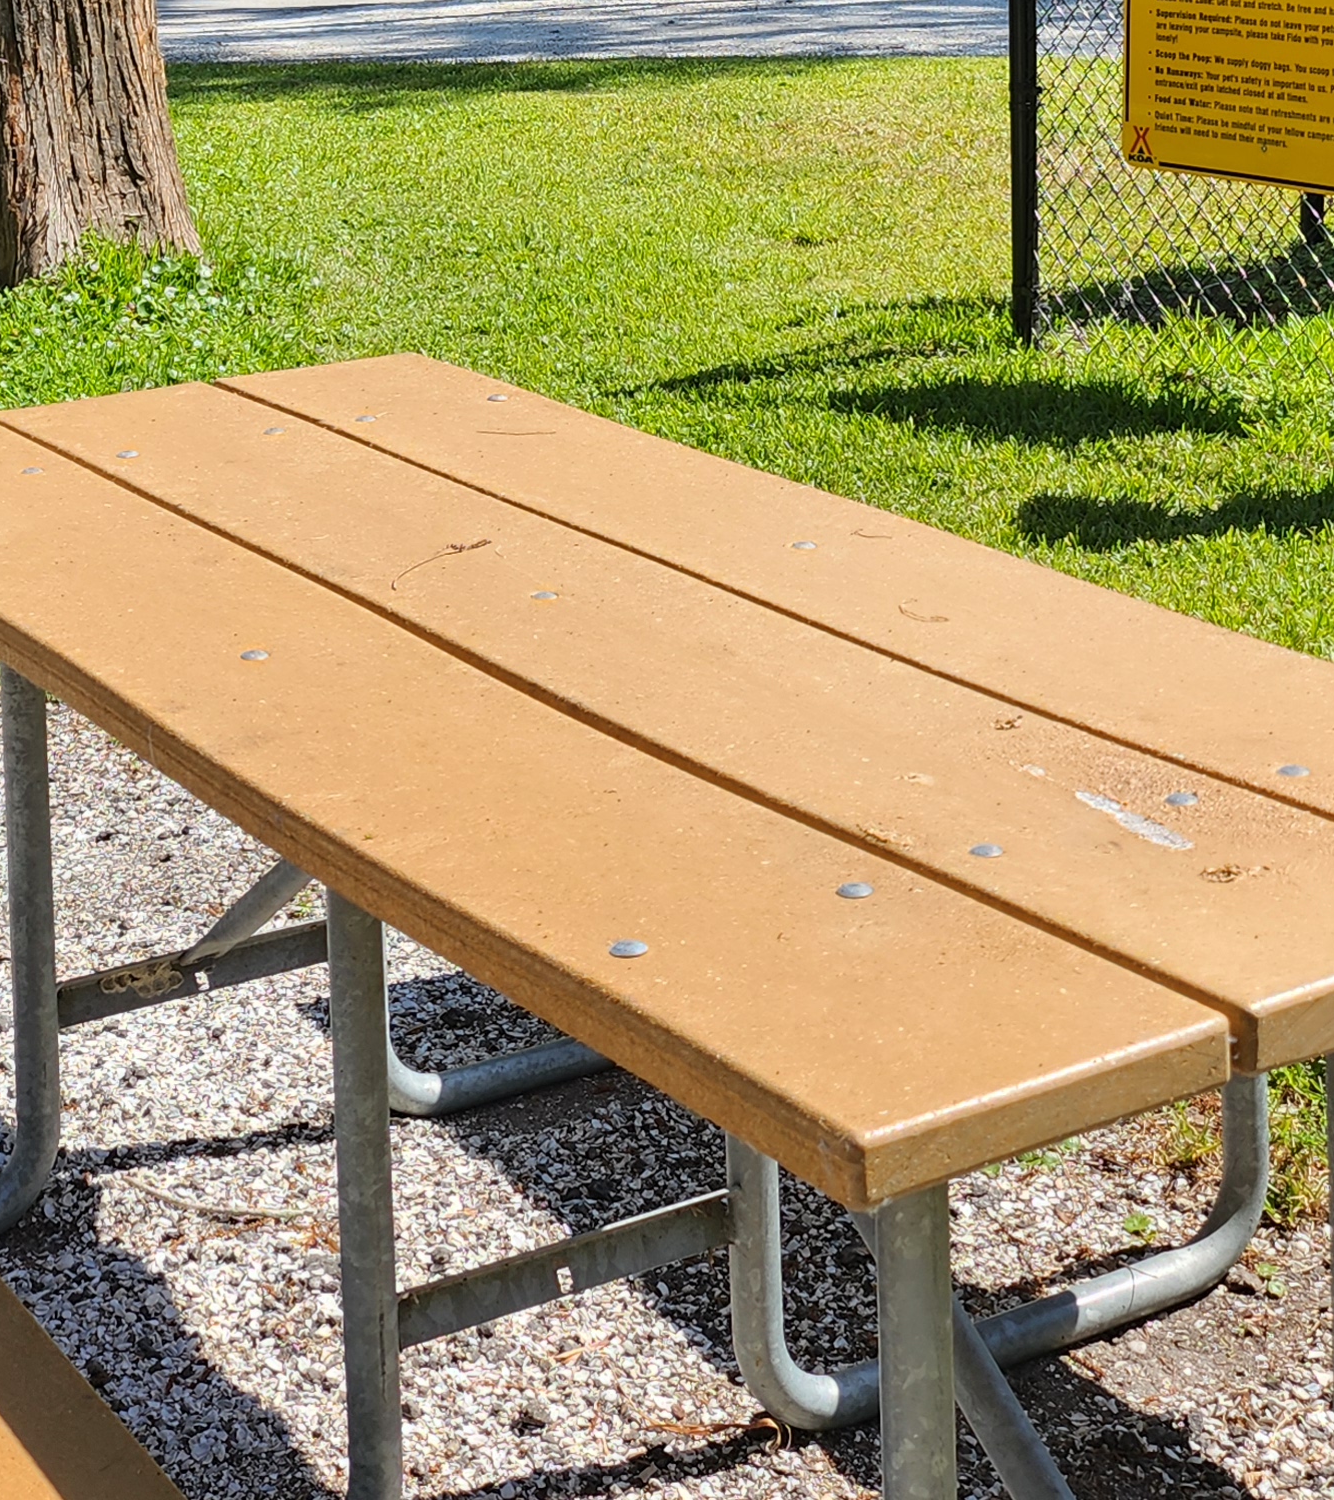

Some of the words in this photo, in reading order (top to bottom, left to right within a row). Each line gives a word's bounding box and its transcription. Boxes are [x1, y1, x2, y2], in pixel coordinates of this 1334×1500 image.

[1231, 0, 1241, 8] out
[1243, 0, 1256, 9] and
[1287, 3, 1295, 12] Be
[1297, 4, 1311, 14] free
[1314, 6, 1327, 15] and
[1156, 8, 1197, 20] Supervision
[1234, 15, 1257, 26] Please
[1259, 18, 1268, 27] do
[1270, 20, 1281, 28] not
[1283, 20, 1302, 30] leave
[1304, 24, 1320, 32] your
[1169, 22, 1193, 34] leaving
[1195, 26, 1209, 34] your
[1246, 30, 1268, 39] please
[1271, 32, 1285, 41] take
[1287, 33, 1301, 43] Fido
[1304, 35, 1319, 44] with
[1321, 38, 1333, 47] you
[1155, 49, 1176, 60] Scoop
[1179, 51, 1190, 60] the
[1214, 55, 1225, 64] We
[1227, 57, 1248, 68] supply
[1251, 59, 1271, 71] doggy
[1295, 63, 1307, 74] You
[1309, 66, 1329, 77] scoop
[1155, 66, 1164, 74] No
[1206, 71, 1220, 80] Your
[1241, 76, 1262, 87] safety
[1264, 77, 1270, 87] is
[1272, 78, 1306, 90] important
[1309, 82, 1315, 91] to
[1200, 83, 1214, 92] gate
[1216, 84, 1241, 96] latched
[1243, 87, 1265, 99] closed
[1268, 91, 1274, 99] at
[1277, 92, 1285, 100] all
[1155, 94, 1171, 104] Food
[1174, 96, 1186, 106] and
[1214, 101, 1236, 112] Please
[1239, 104, 1253, 114] note
[1256, 106, 1269, 116] that
[1319, 115, 1330, 124] are
[1155, 110, 1173, 121] Quiet
[1196, 115, 1218, 127] Please
[1221, 118, 1229, 128] be
[1231, 120, 1256, 131] mindful
[1258, 123, 1265, 132] of
[1267, 125, 1282, 135] your
[1285, 126, 1305, 138] fellow
[1155, 123, 1177, 133] friends
[1180, 126, 1191, 135] will
[1194, 127, 1210, 138] need
[1212, 130, 1218, 138] to
[1221, 131, 1237, 141] mind
[1239, 133, 1254, 143] their
[1129, 154, 1154, 164] KOA
